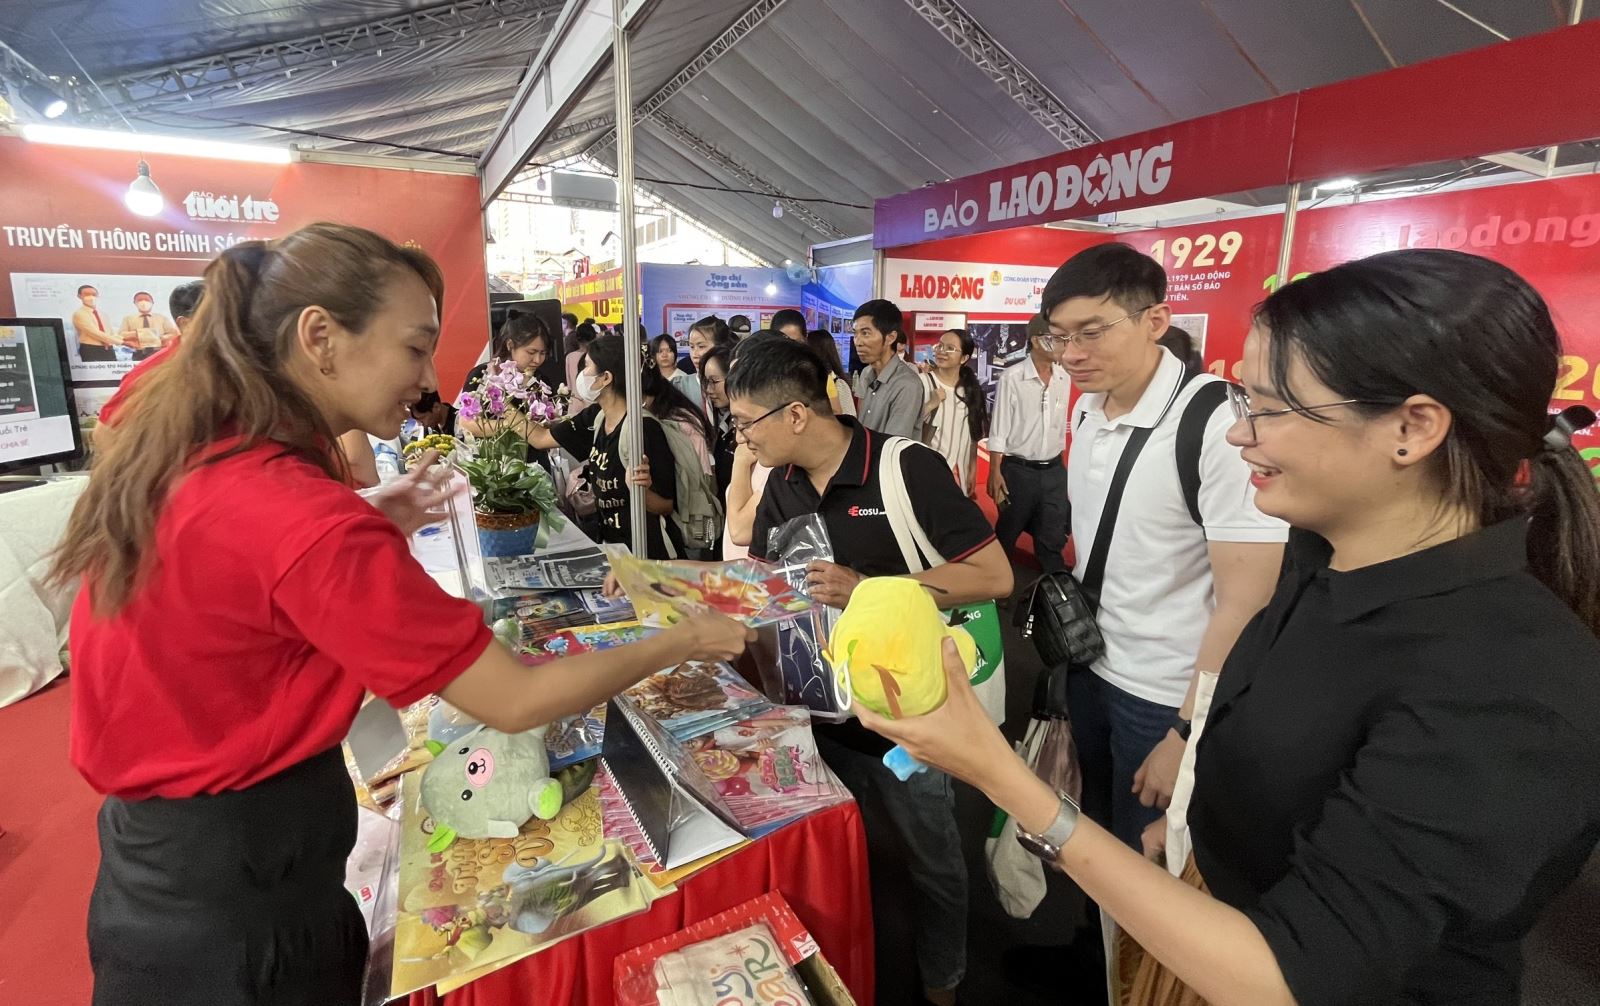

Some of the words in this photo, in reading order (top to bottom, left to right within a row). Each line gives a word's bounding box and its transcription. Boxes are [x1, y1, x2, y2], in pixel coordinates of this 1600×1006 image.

[182, 191, 240, 219] tuổi
[240, 194, 280, 222] trẻ
[924, 189, 979, 233] BÁO
[2, 223, 84, 249] TRUYỀN
[87, 227, 151, 251] THÔNG
[155, 230, 210, 253] CHÍNH
[1151, 231, 1243, 269] 1929
[705, 280, 730, 289] Cộng
[1190, 272, 1206, 281] LAO
[1207, 270, 1231, 280] ĐỘNG
[1192, 281, 1203, 291] SỐ
[1203, 281, 1221, 290] BÁO
[593, 298, 610, 318] 10
